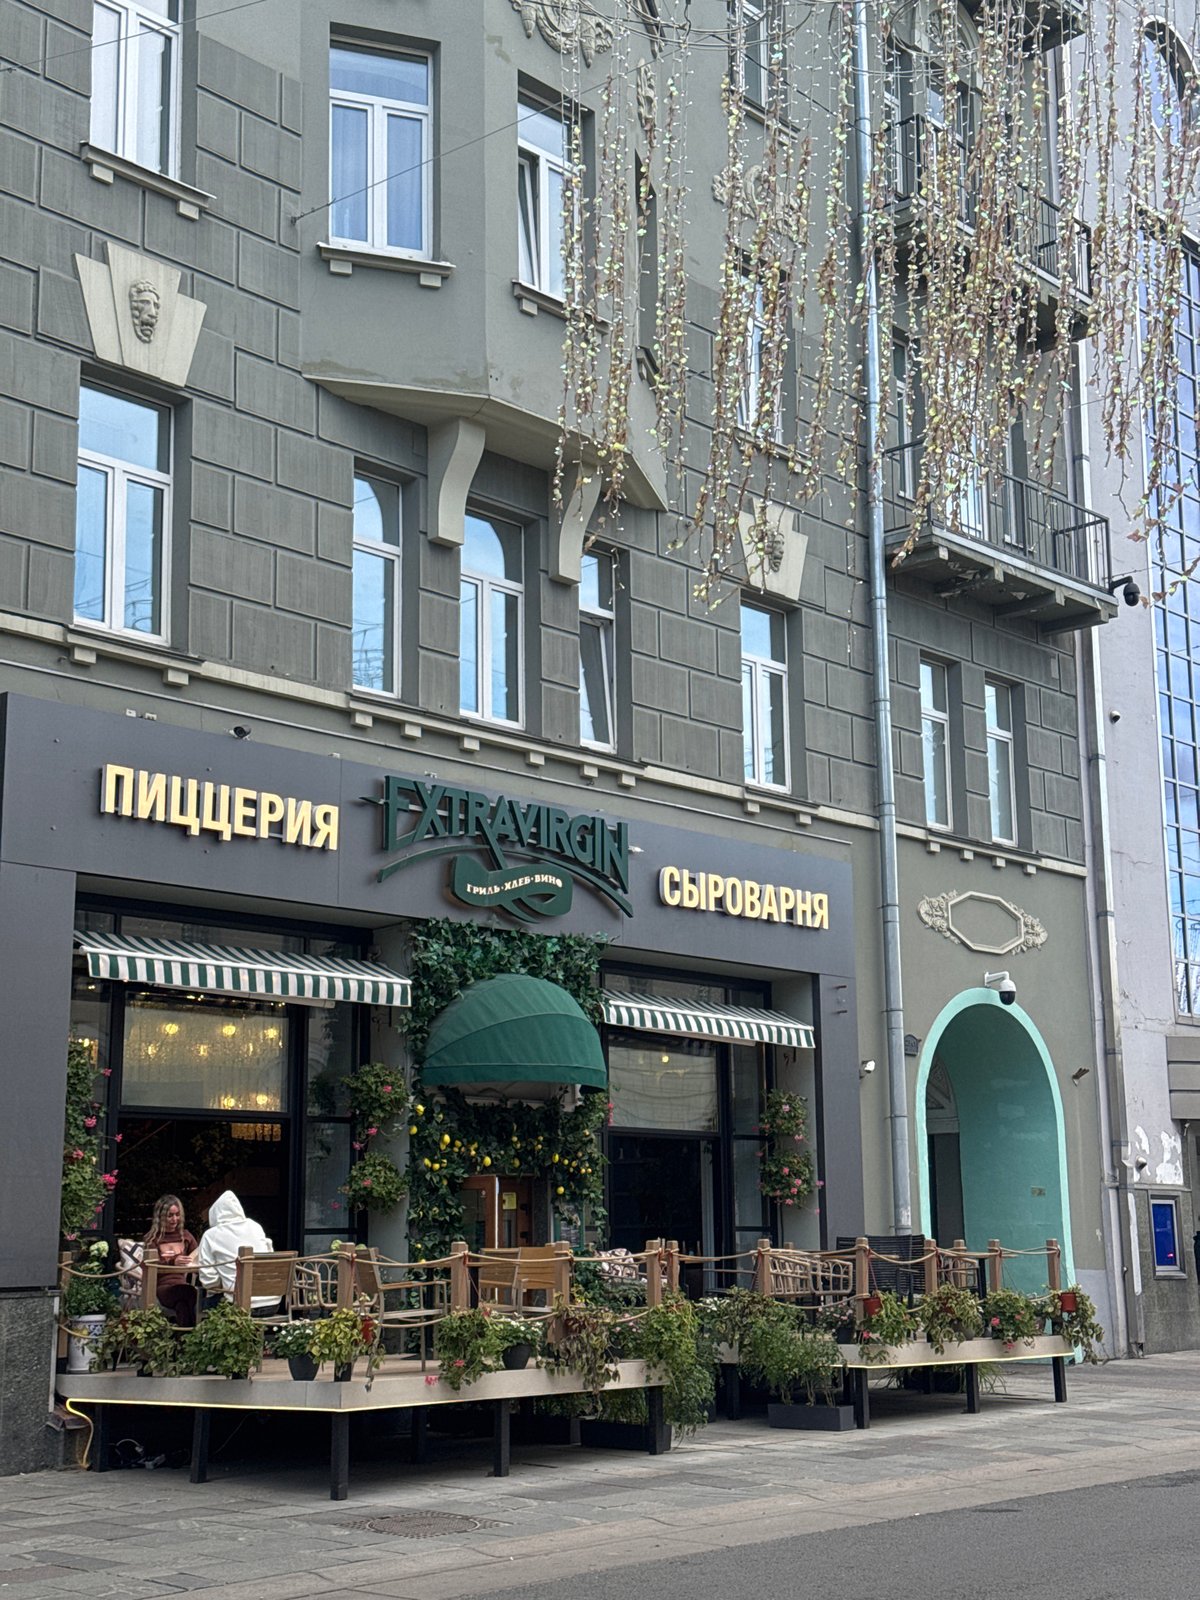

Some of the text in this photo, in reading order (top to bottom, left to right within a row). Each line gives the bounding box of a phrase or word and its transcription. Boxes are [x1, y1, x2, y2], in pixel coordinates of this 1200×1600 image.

[101, 764, 339, 850] ПИЦЦЕРИЯ
[384, 775, 629, 894] EXTRAVIRGIN
[660, 866, 829, 930] СЫРОВАРНЯ
